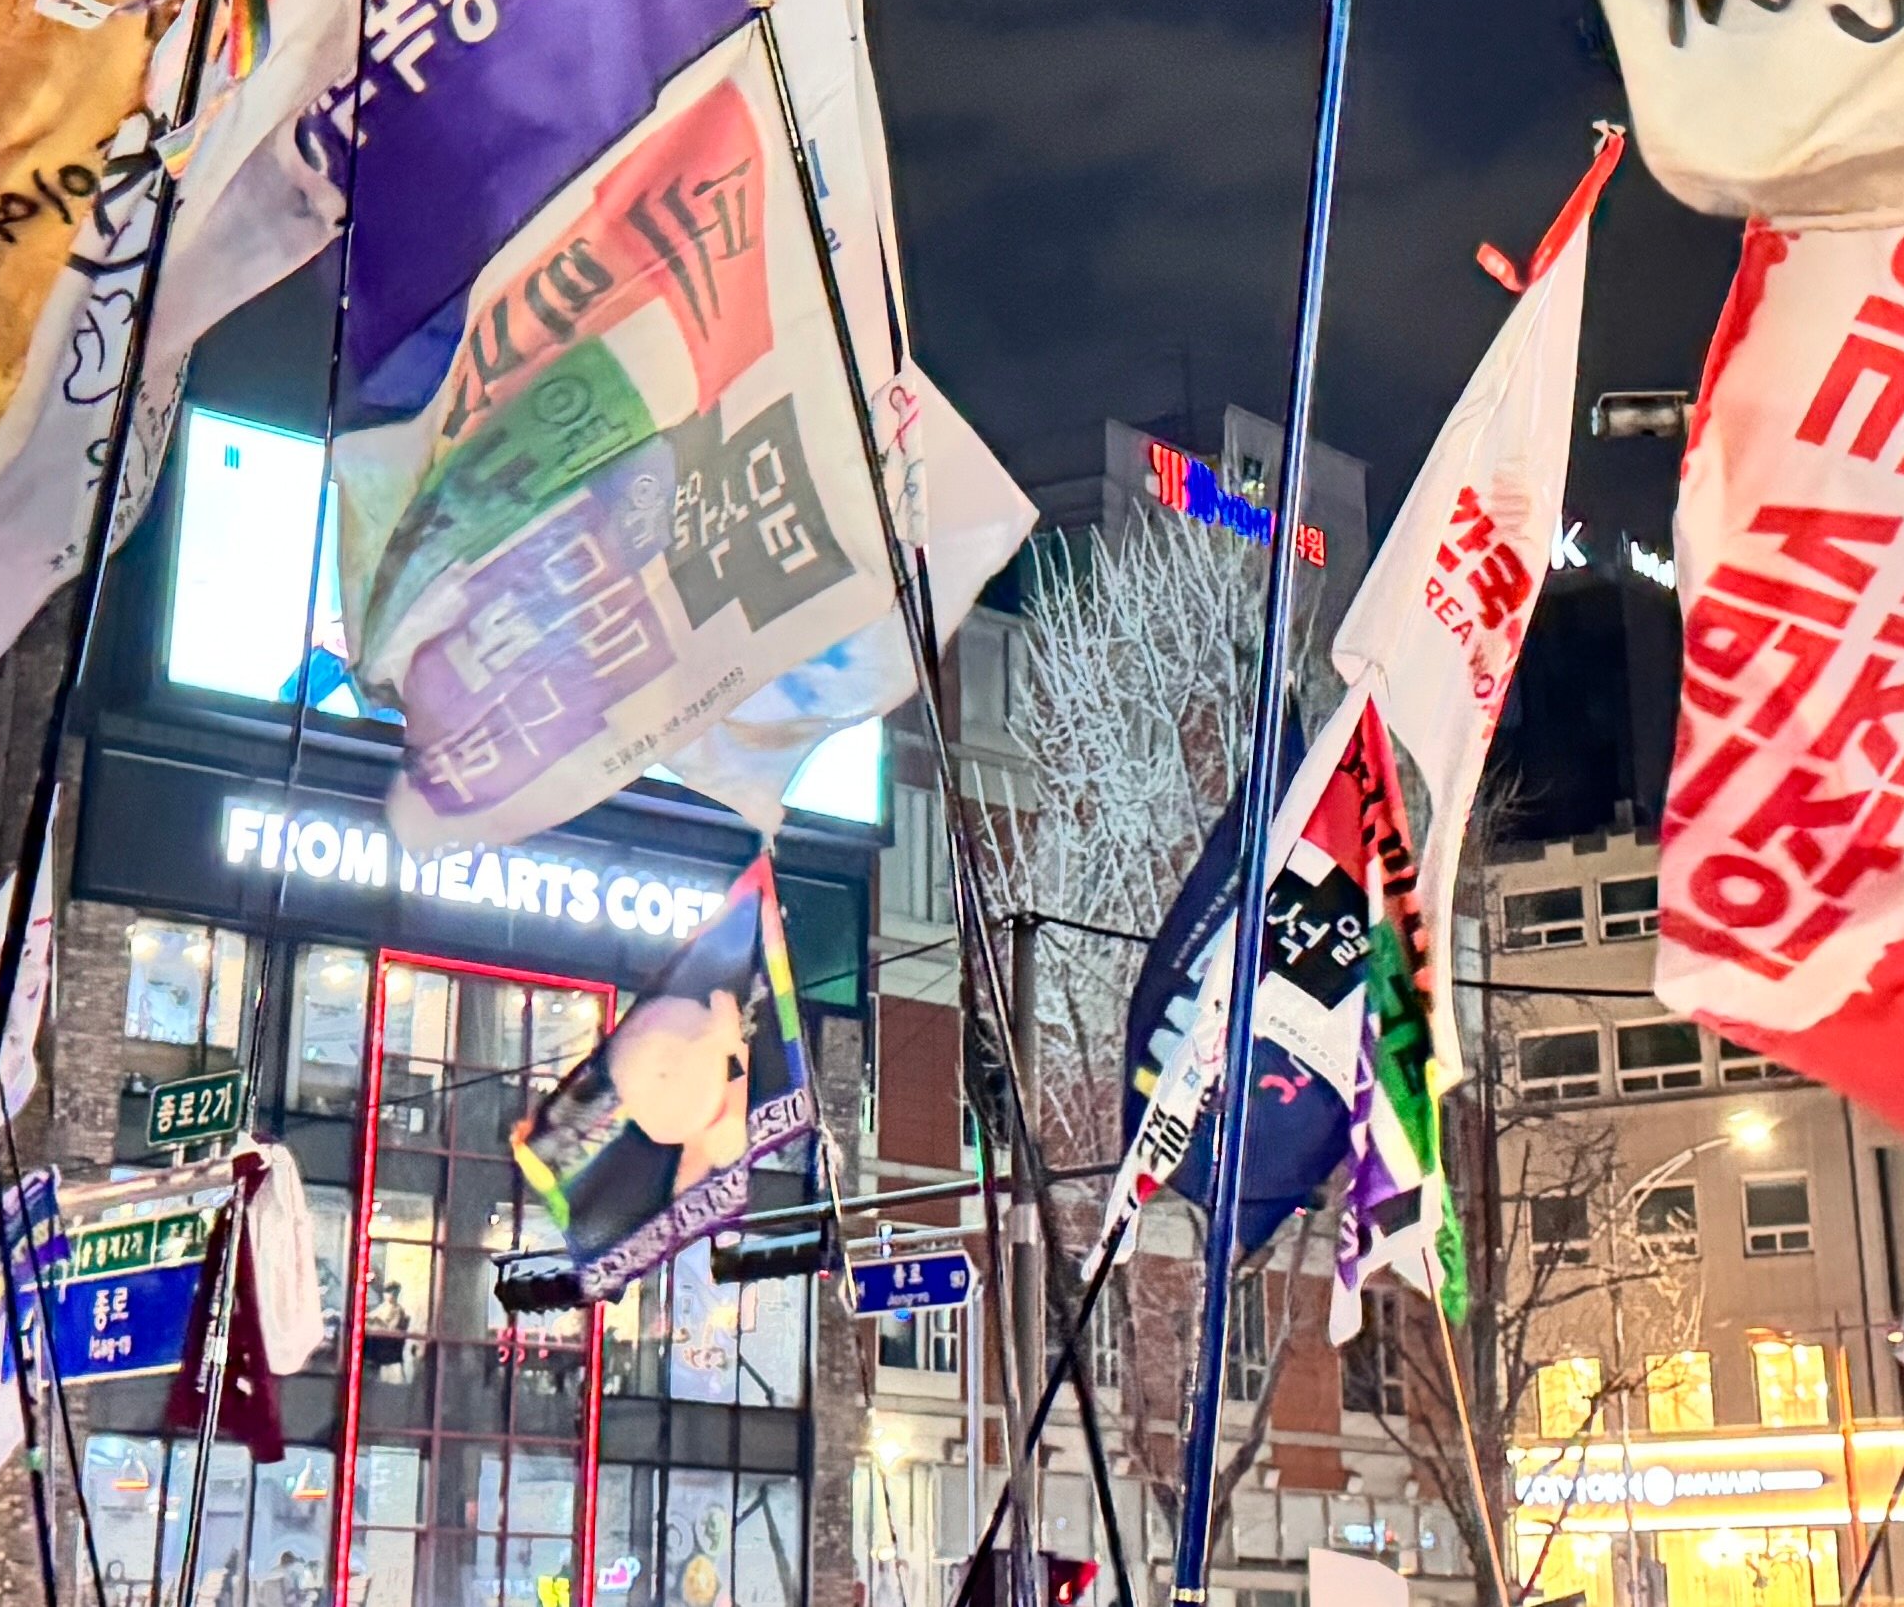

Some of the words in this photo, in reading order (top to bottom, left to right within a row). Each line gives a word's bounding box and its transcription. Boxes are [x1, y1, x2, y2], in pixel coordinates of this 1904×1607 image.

[226, 807, 387, 887] FROM
[154, 1083, 235, 1138] 종로2가
[93, 1286, 130, 1331] 종로
